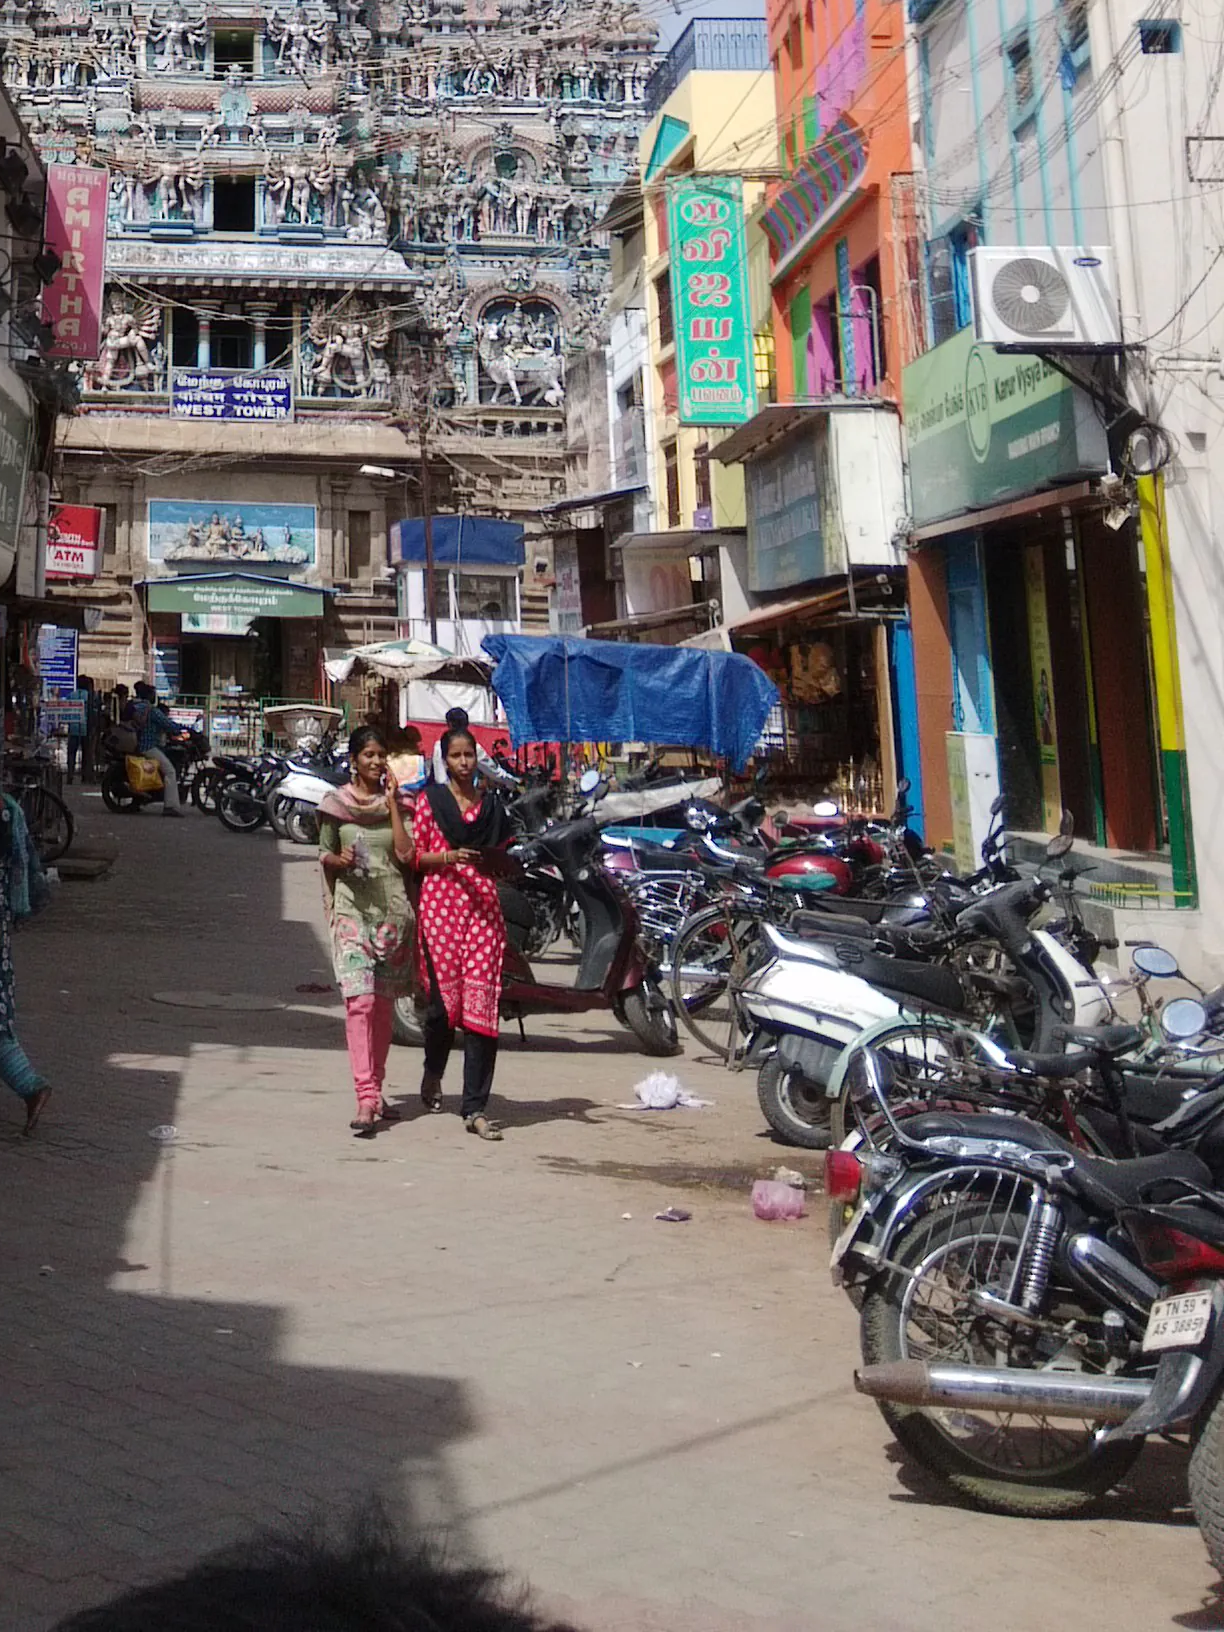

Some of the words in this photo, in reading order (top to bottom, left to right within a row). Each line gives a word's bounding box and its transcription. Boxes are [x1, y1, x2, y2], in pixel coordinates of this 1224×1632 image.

[56, 169, 102, 187] HOTEL
[692, 202, 718, 220] M
[57, 186, 91, 337] AMIRTHA
[994, 376, 1016, 403] Karur
[1016, 360, 1042, 398] Vysya
[967, 383, 988, 417] KVB
[177, 404, 226, 416] WEST
[233, 405, 288, 418] TOWER
[54, 550, 84, 563] ATM
[1165, 1300, 1181, 1316] TN
[1182, 1298, 1196, 1314] 59
[1152, 1321, 1169, 1337] AS
